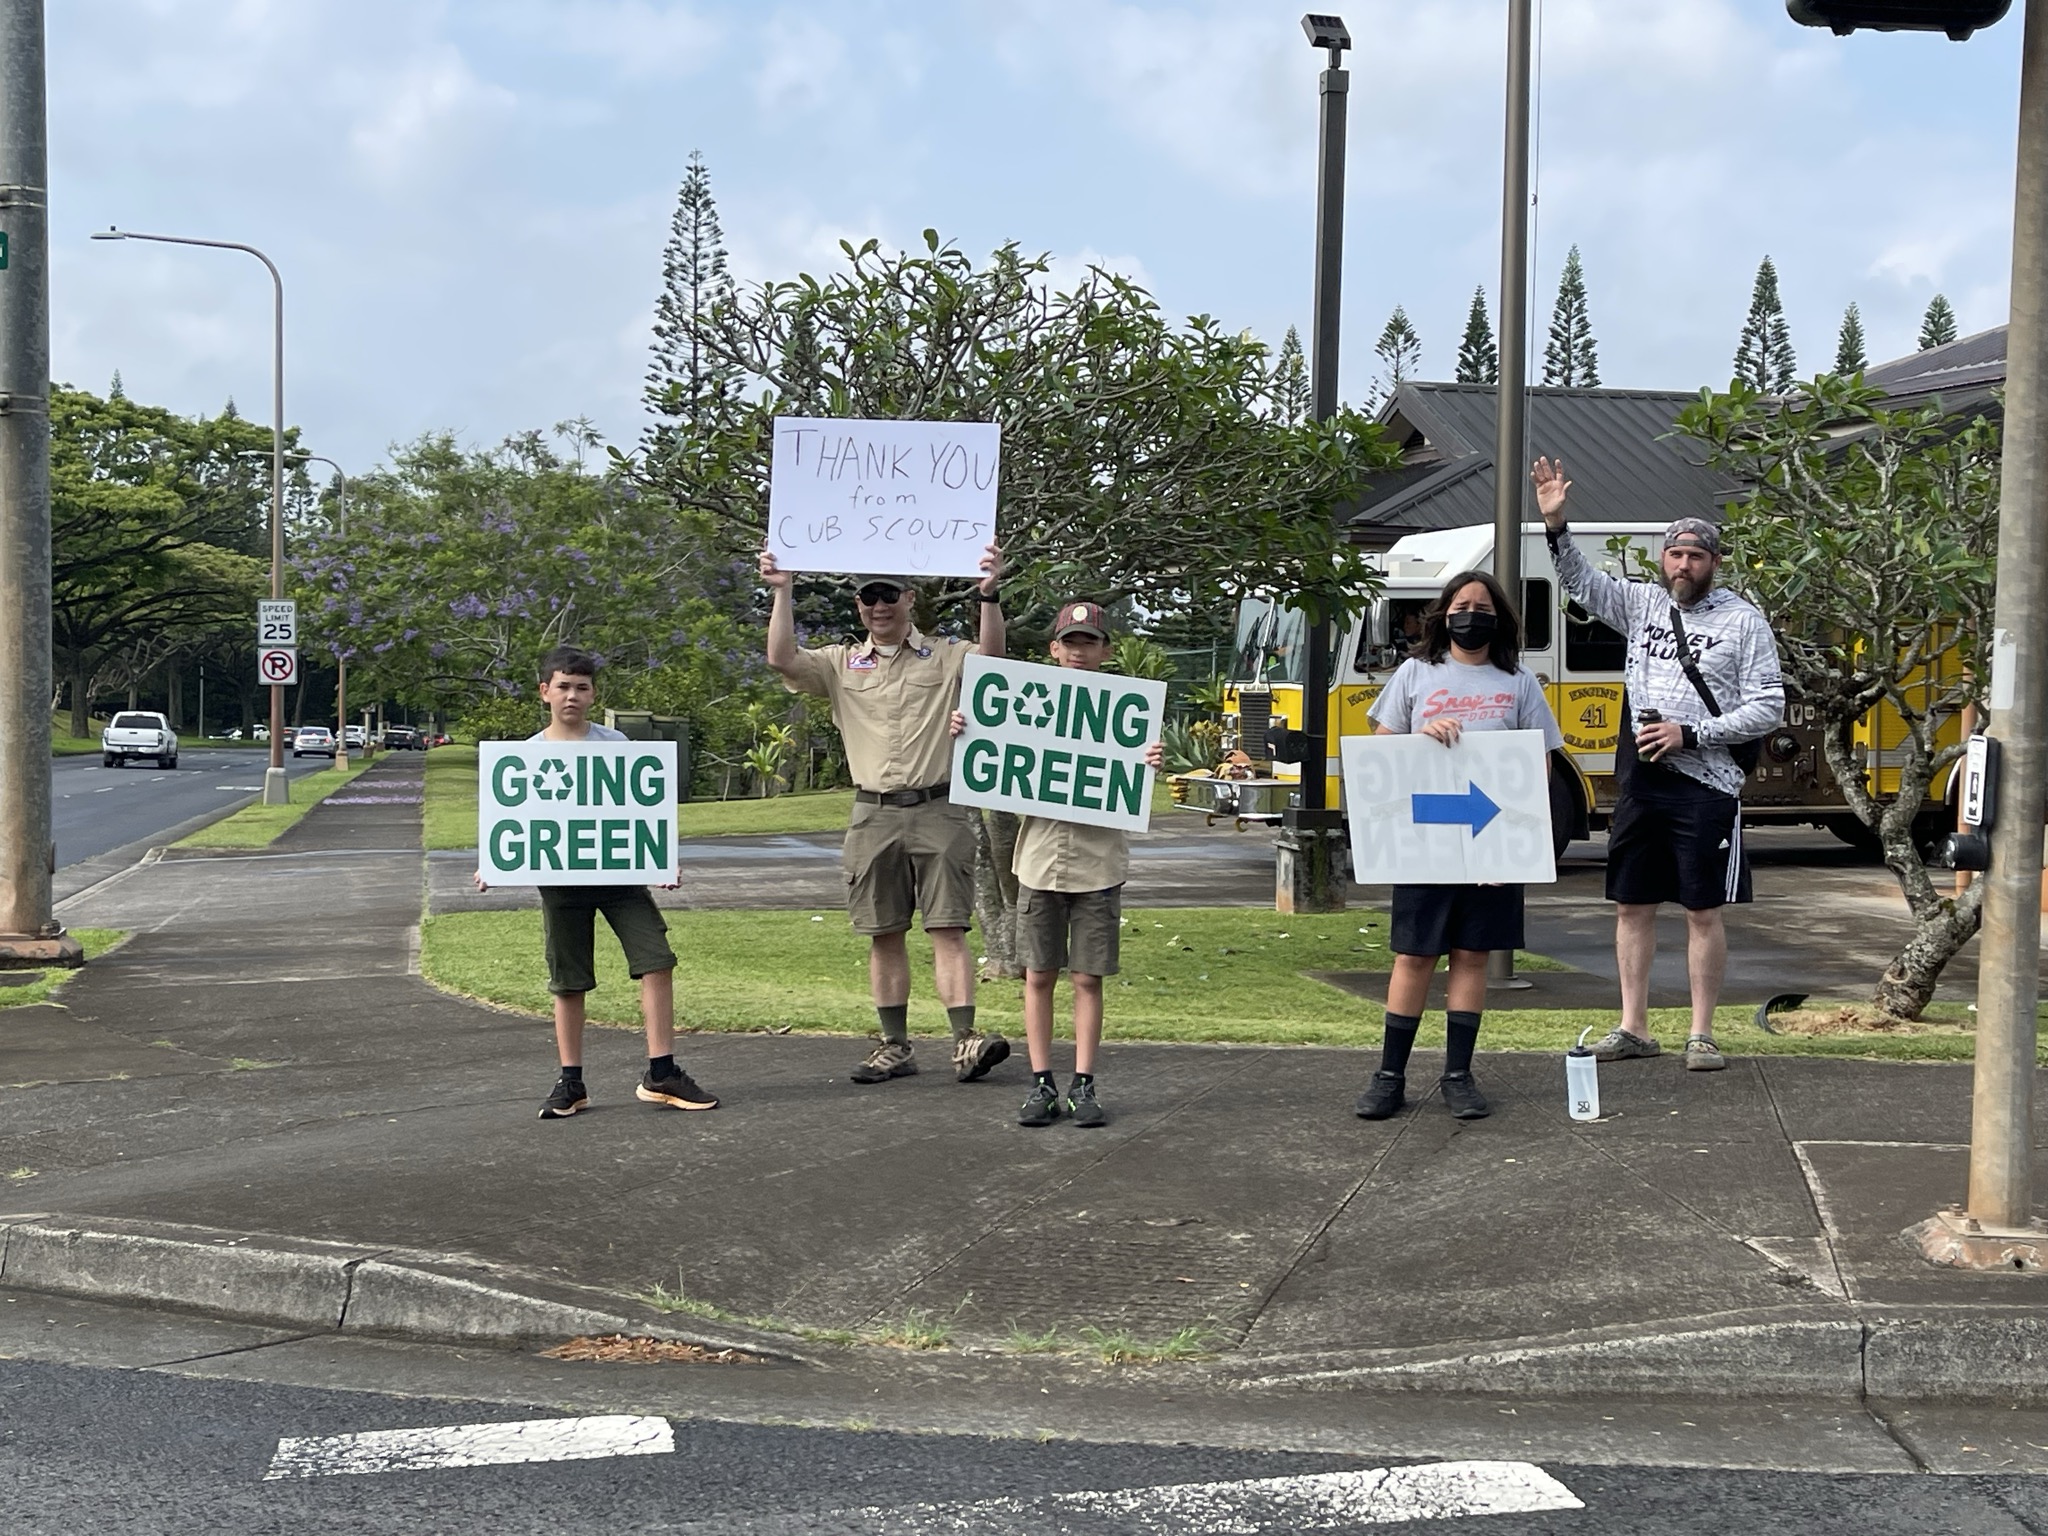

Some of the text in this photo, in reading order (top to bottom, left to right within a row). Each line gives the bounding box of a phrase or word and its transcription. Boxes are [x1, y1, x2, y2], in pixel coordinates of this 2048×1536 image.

[780, 428, 997, 491] THANK YOU
[848, 484, 917, 509] from
[778, 515, 988, 549] CUB SCOUTS
[262, 605, 293, 613] SPEED
[265, 614, 290, 622] LIMIT
[264, 623, 292, 640] 25
[1644, 622, 1724, 650] HOCEY
[1568, 686, 1619, 702] ENGINE
[1579, 703, 1608, 729] 41
[962, 738, 1146, 816] GREEN
[489, 819, 668, 872] GREEN
